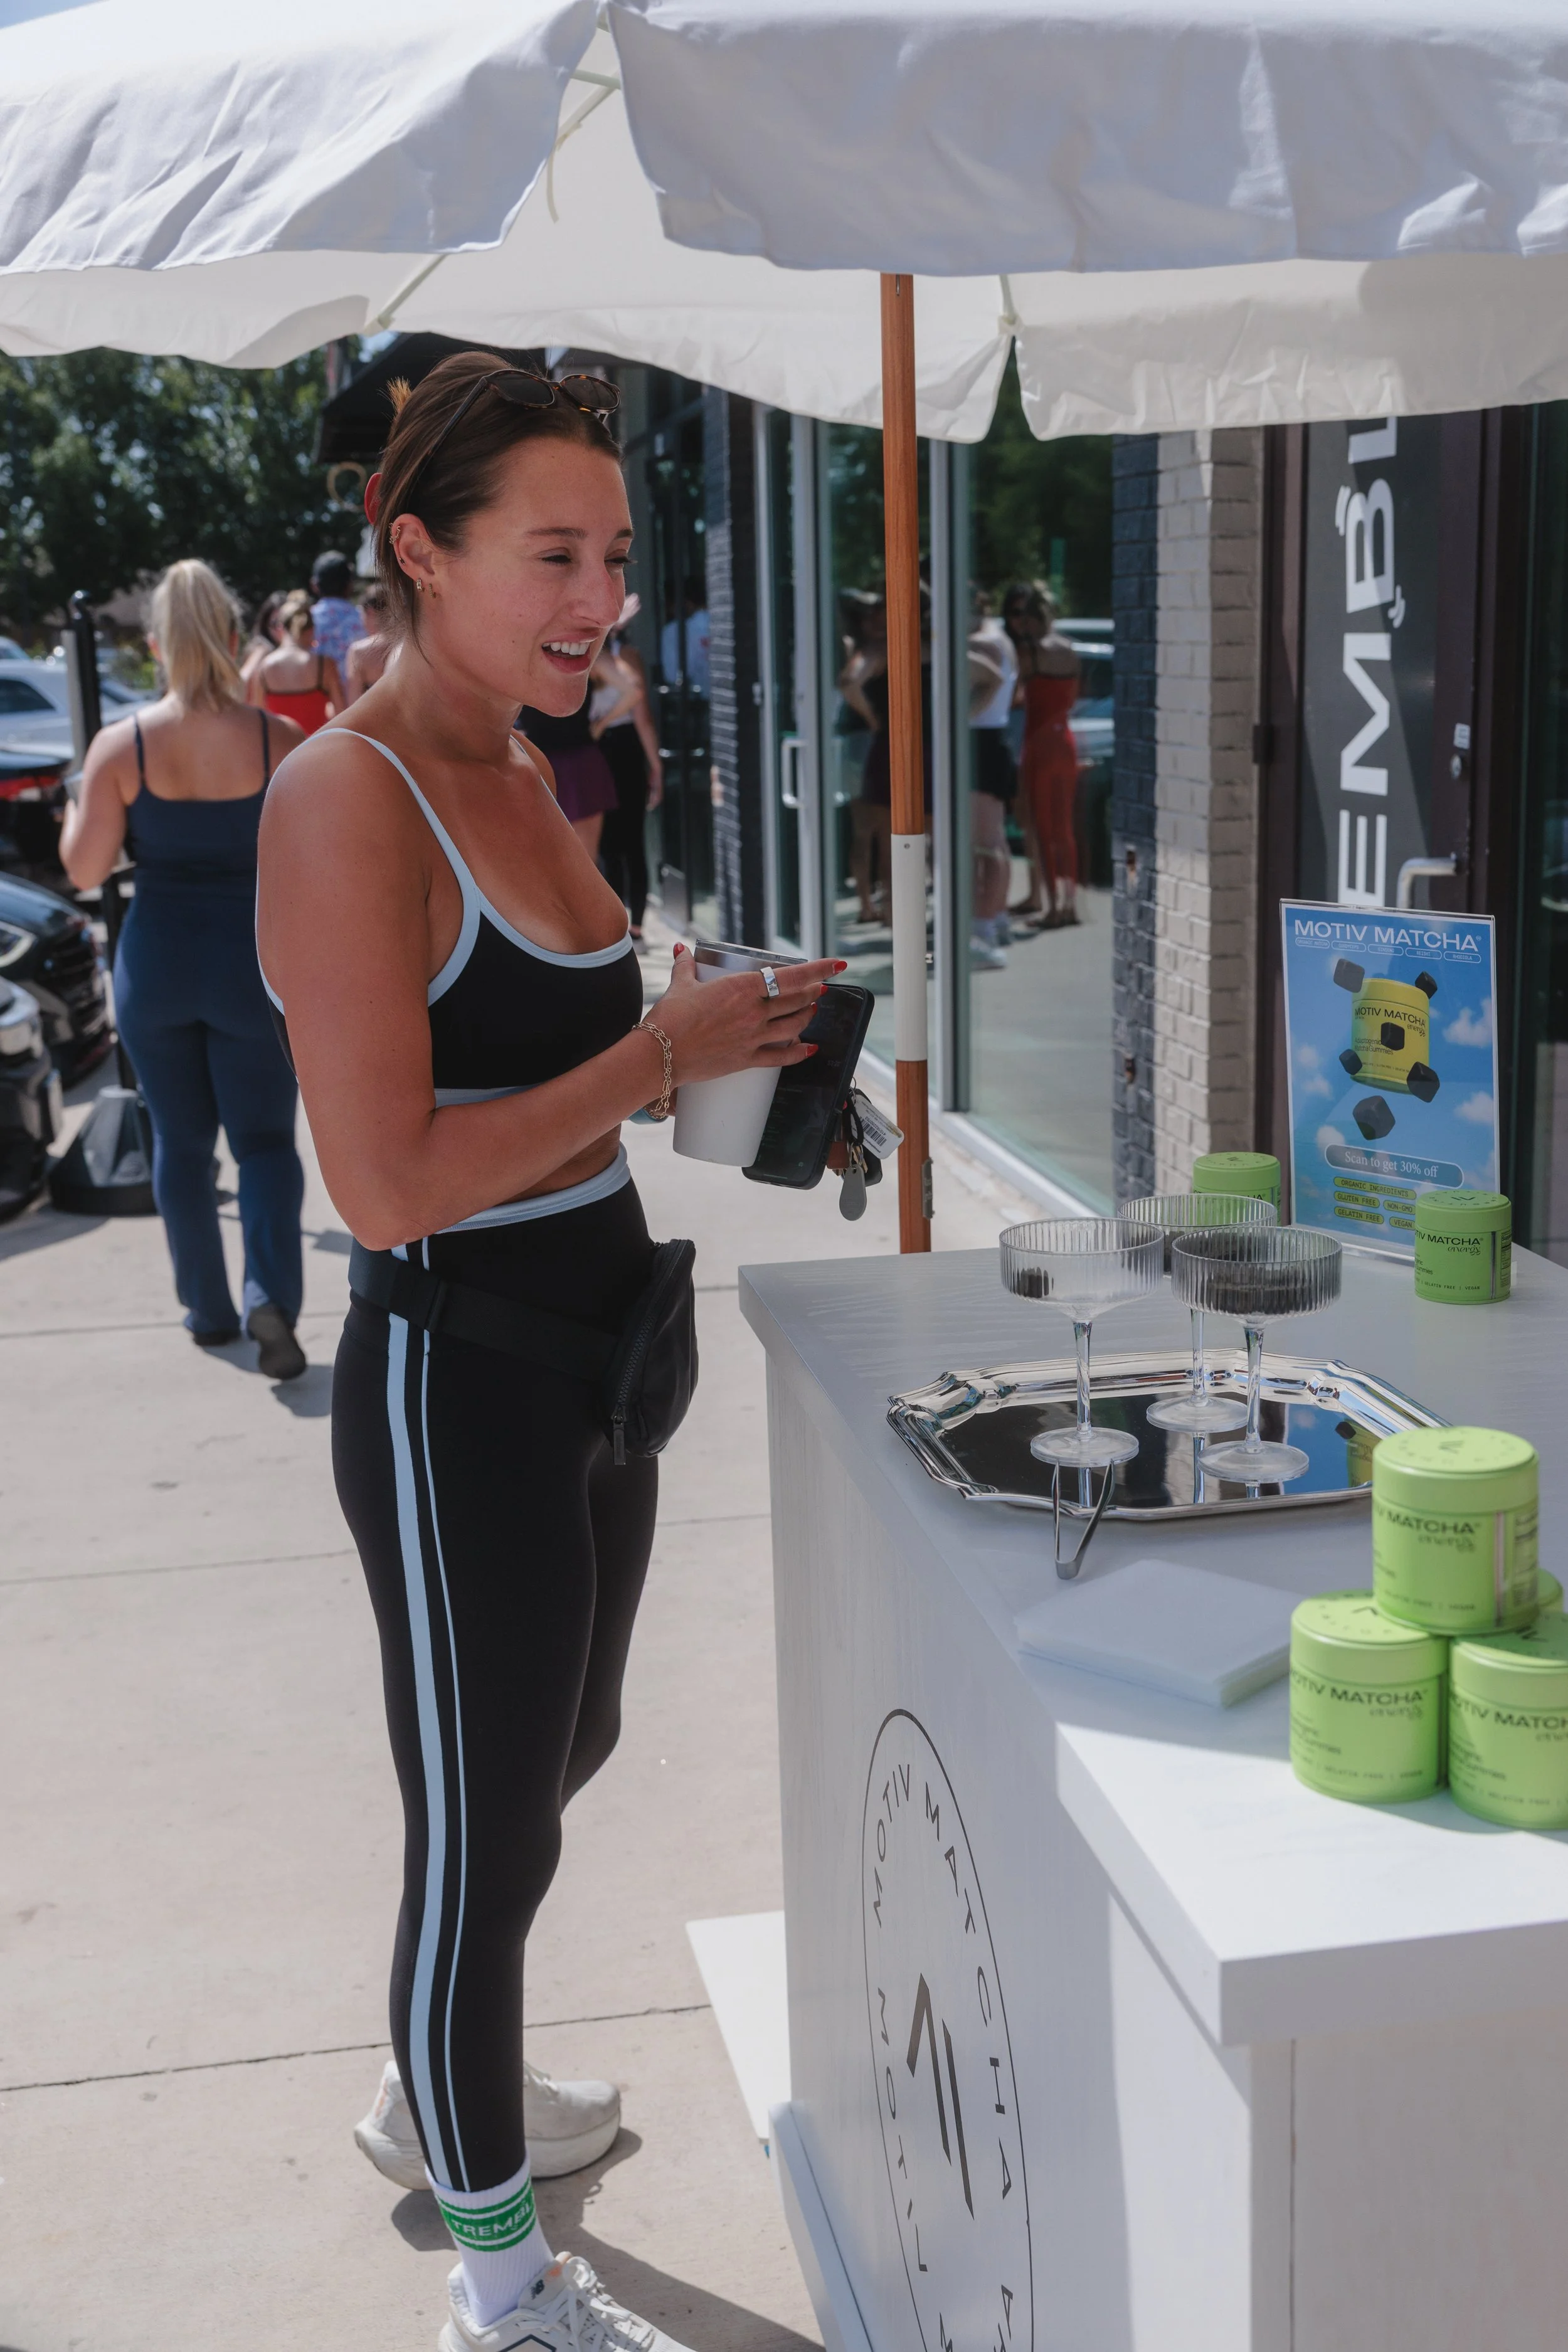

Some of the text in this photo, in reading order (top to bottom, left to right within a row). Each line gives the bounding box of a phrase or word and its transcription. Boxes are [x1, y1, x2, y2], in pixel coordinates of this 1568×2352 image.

[1295, 919, 1367, 941] MOTIV
[1355, 1007, 1426, 1027] MOTIV MATCHA
[1369, 1045, 1394, 1056] Gummies
[1345, 1151, 1439, 1178] Scan to get 30% off
[1341, 1179, 1366, 1190] ORGANIC
[1370, 1184, 1409, 1197] INGREDIENTS
[1337, 1193, 1376, 1206] GLUTEN FREE
[1387, 1202, 1412, 1212] NON-GMO
[1338, 1208, 1380, 1222] GELATIN FREE
[1394, 1219, 1412, 1228] VEGAN
[1415, 1230, 1426, 1239] TIV
[1447, 1245, 1481, 1256] energy
[873, 1764, 909, 1929] MOTIV
